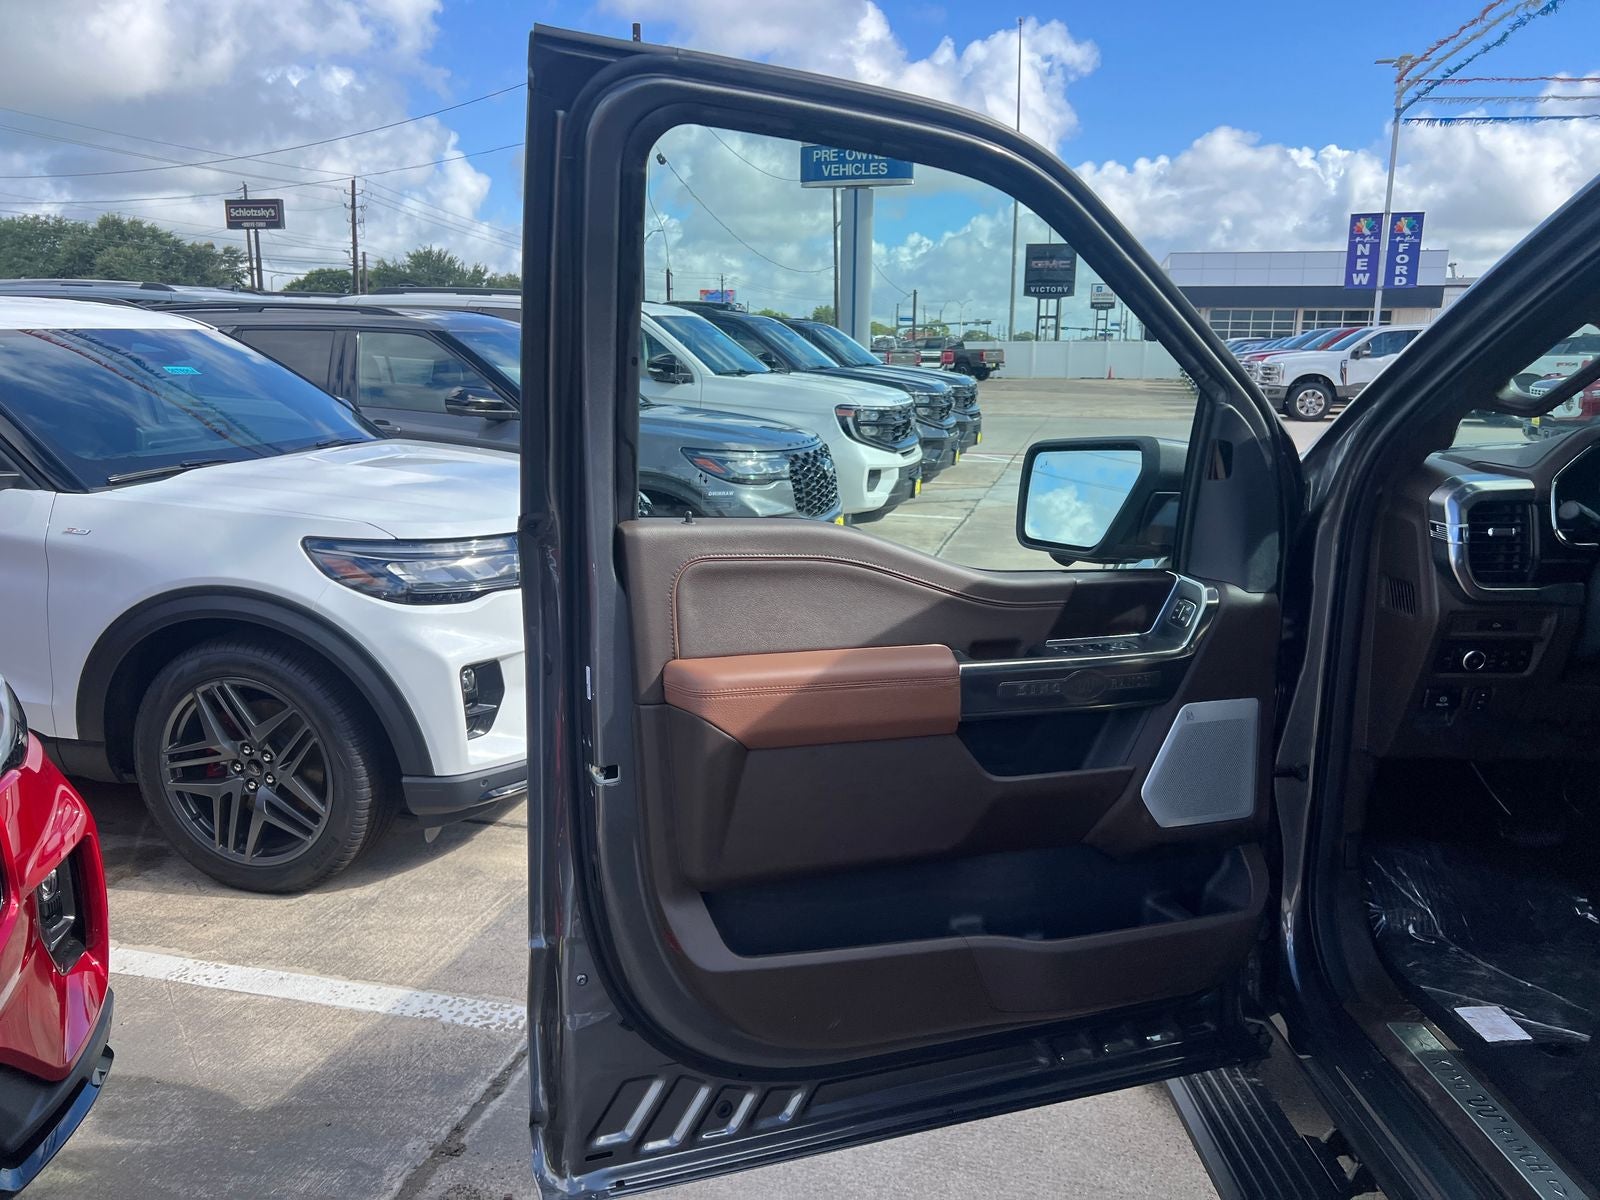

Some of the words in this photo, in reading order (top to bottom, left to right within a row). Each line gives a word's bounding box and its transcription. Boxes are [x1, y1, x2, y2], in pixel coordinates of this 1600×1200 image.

[822, 162, 888, 176] VEHICLES
[230, 208, 275, 218] Schlotzsky's
[1031, 260, 1071, 269] GMC
[1352, 243, 1370, 285] NEW
[1394, 243, 1410, 286] FORD
